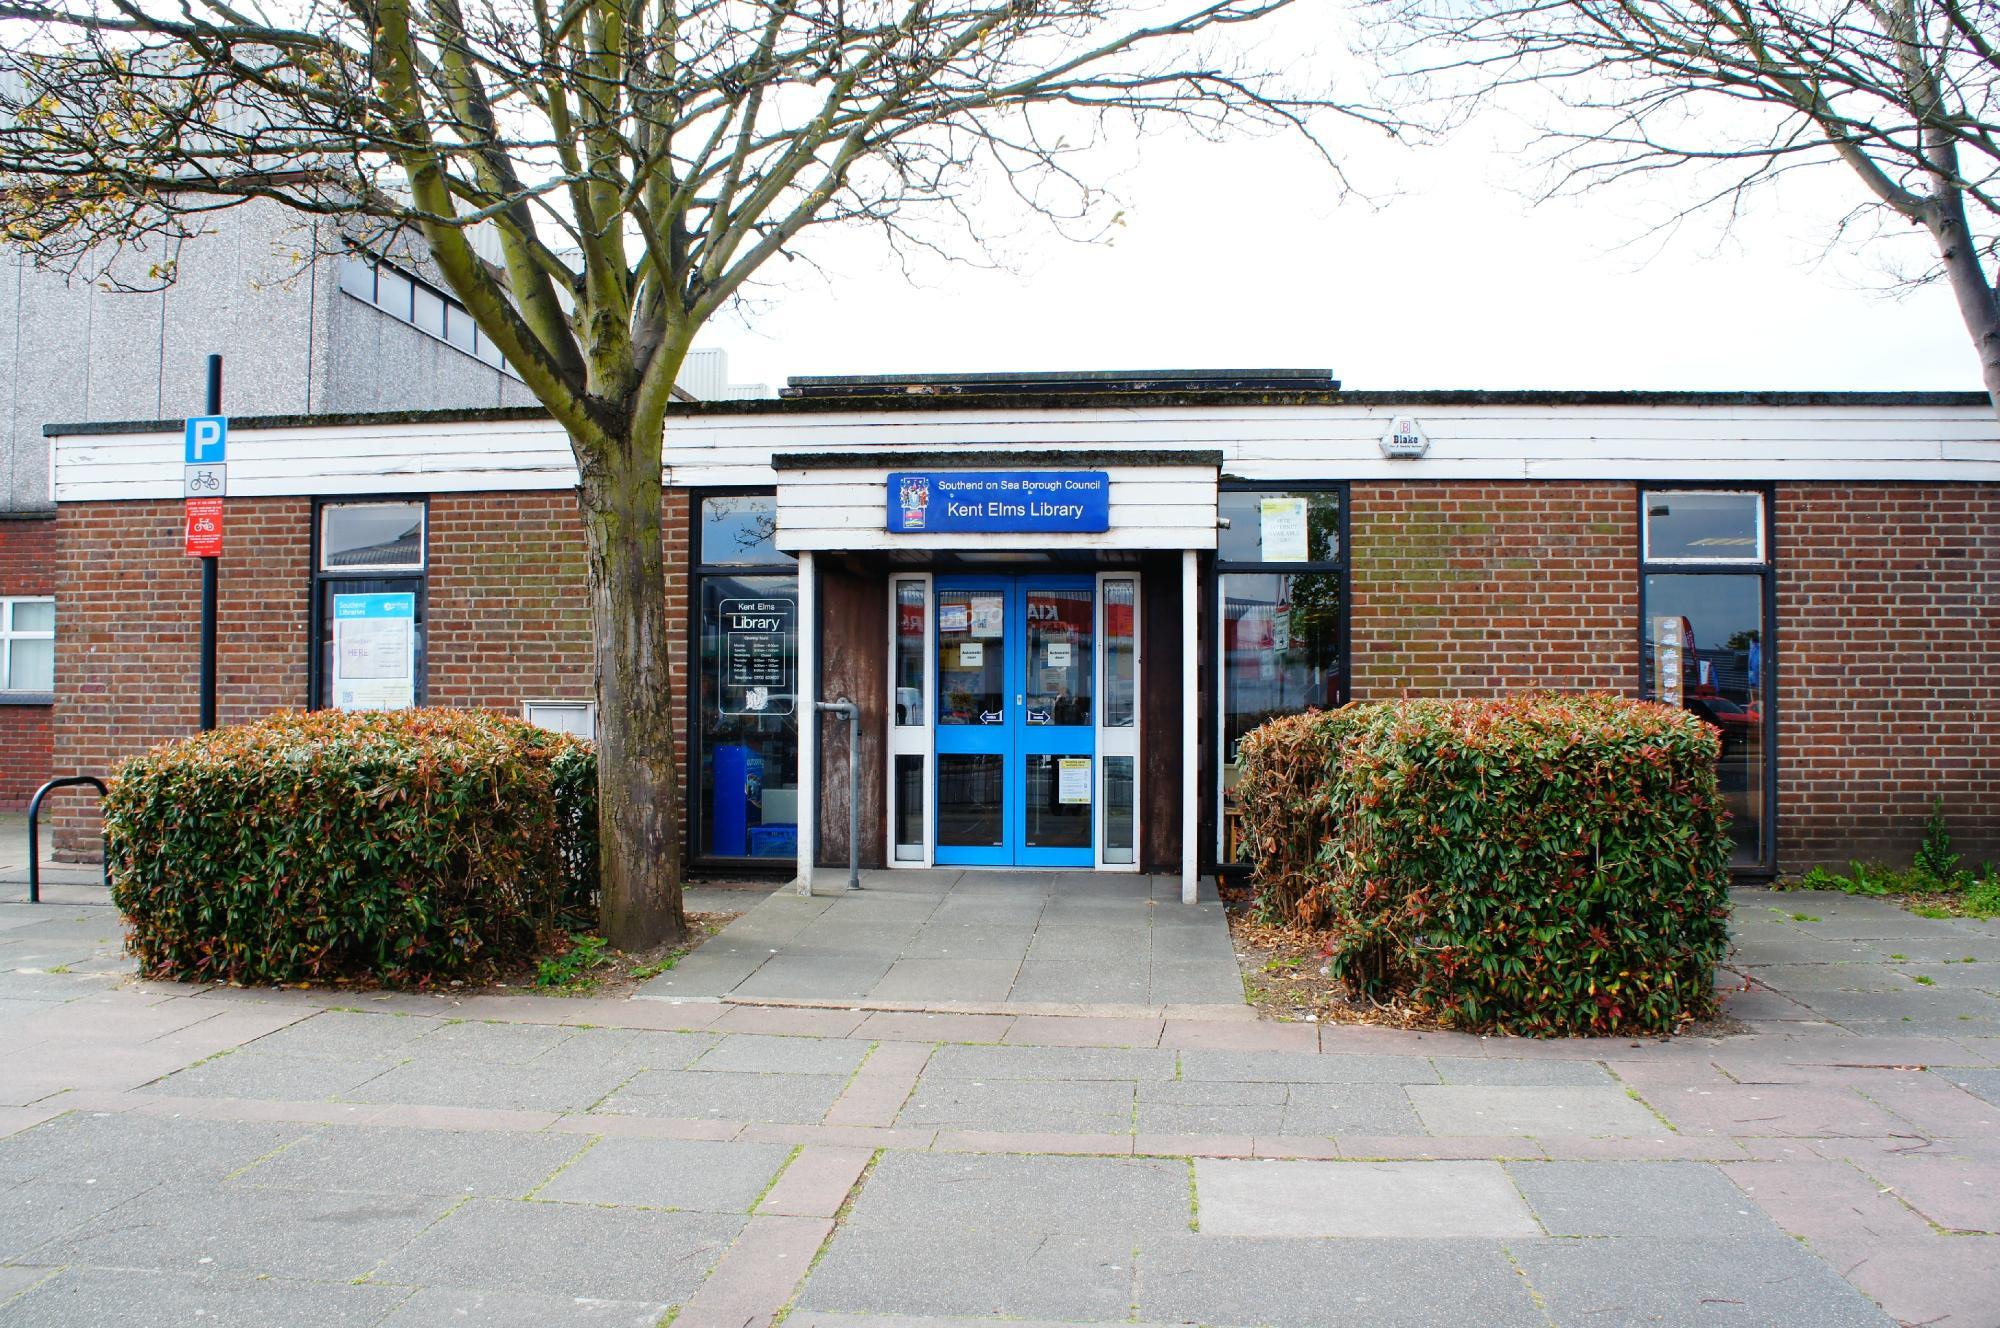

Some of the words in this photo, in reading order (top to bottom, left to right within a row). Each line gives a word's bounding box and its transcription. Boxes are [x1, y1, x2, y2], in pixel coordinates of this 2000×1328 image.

[194, 421, 221, 460] P
[1393, 435, 1418, 444] Blake
[938, 480, 983, 490] Southend
[986, 482, 998, 490] on
[1000, 480, 1019, 490] Sea
[1022, 481, 1062, 491] Borough
[1065, 480, 1100, 490] Council
[947, 502, 983, 517] Kent
[988, 502, 1025, 517] Elms
[1030, 502, 1084, 519] Library
[738, 603, 755, 611] Kent
[757, 603, 775, 611] Elms
[733, 616, 780, 631] Library
